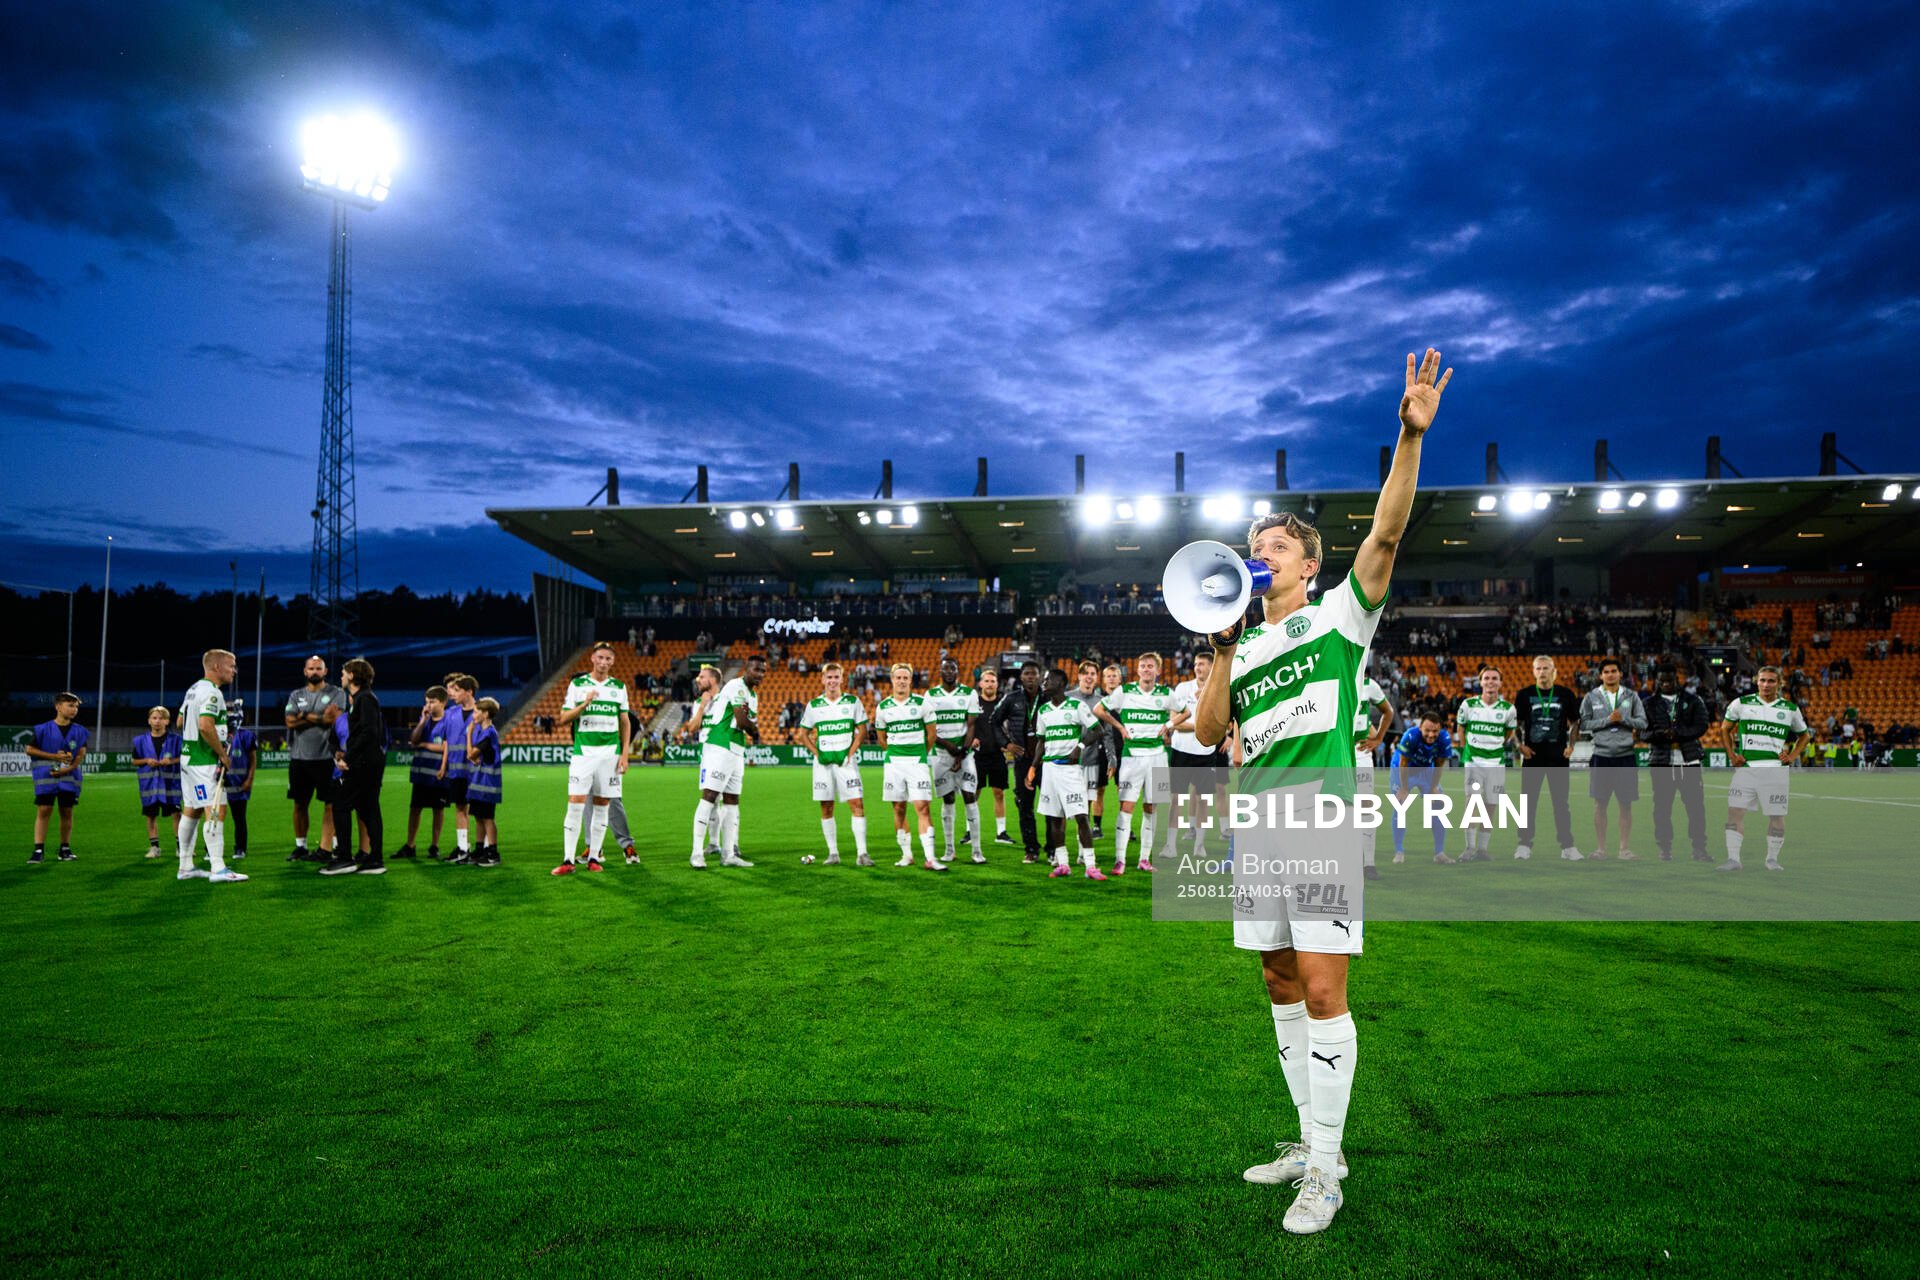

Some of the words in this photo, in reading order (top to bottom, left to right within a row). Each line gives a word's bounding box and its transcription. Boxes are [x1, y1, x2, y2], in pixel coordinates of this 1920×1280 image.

[819, 722, 850, 731] HITACHI
[1747, 723, 1785, 735] HITACHI
[1296, 883, 1349, 906] SPOL
